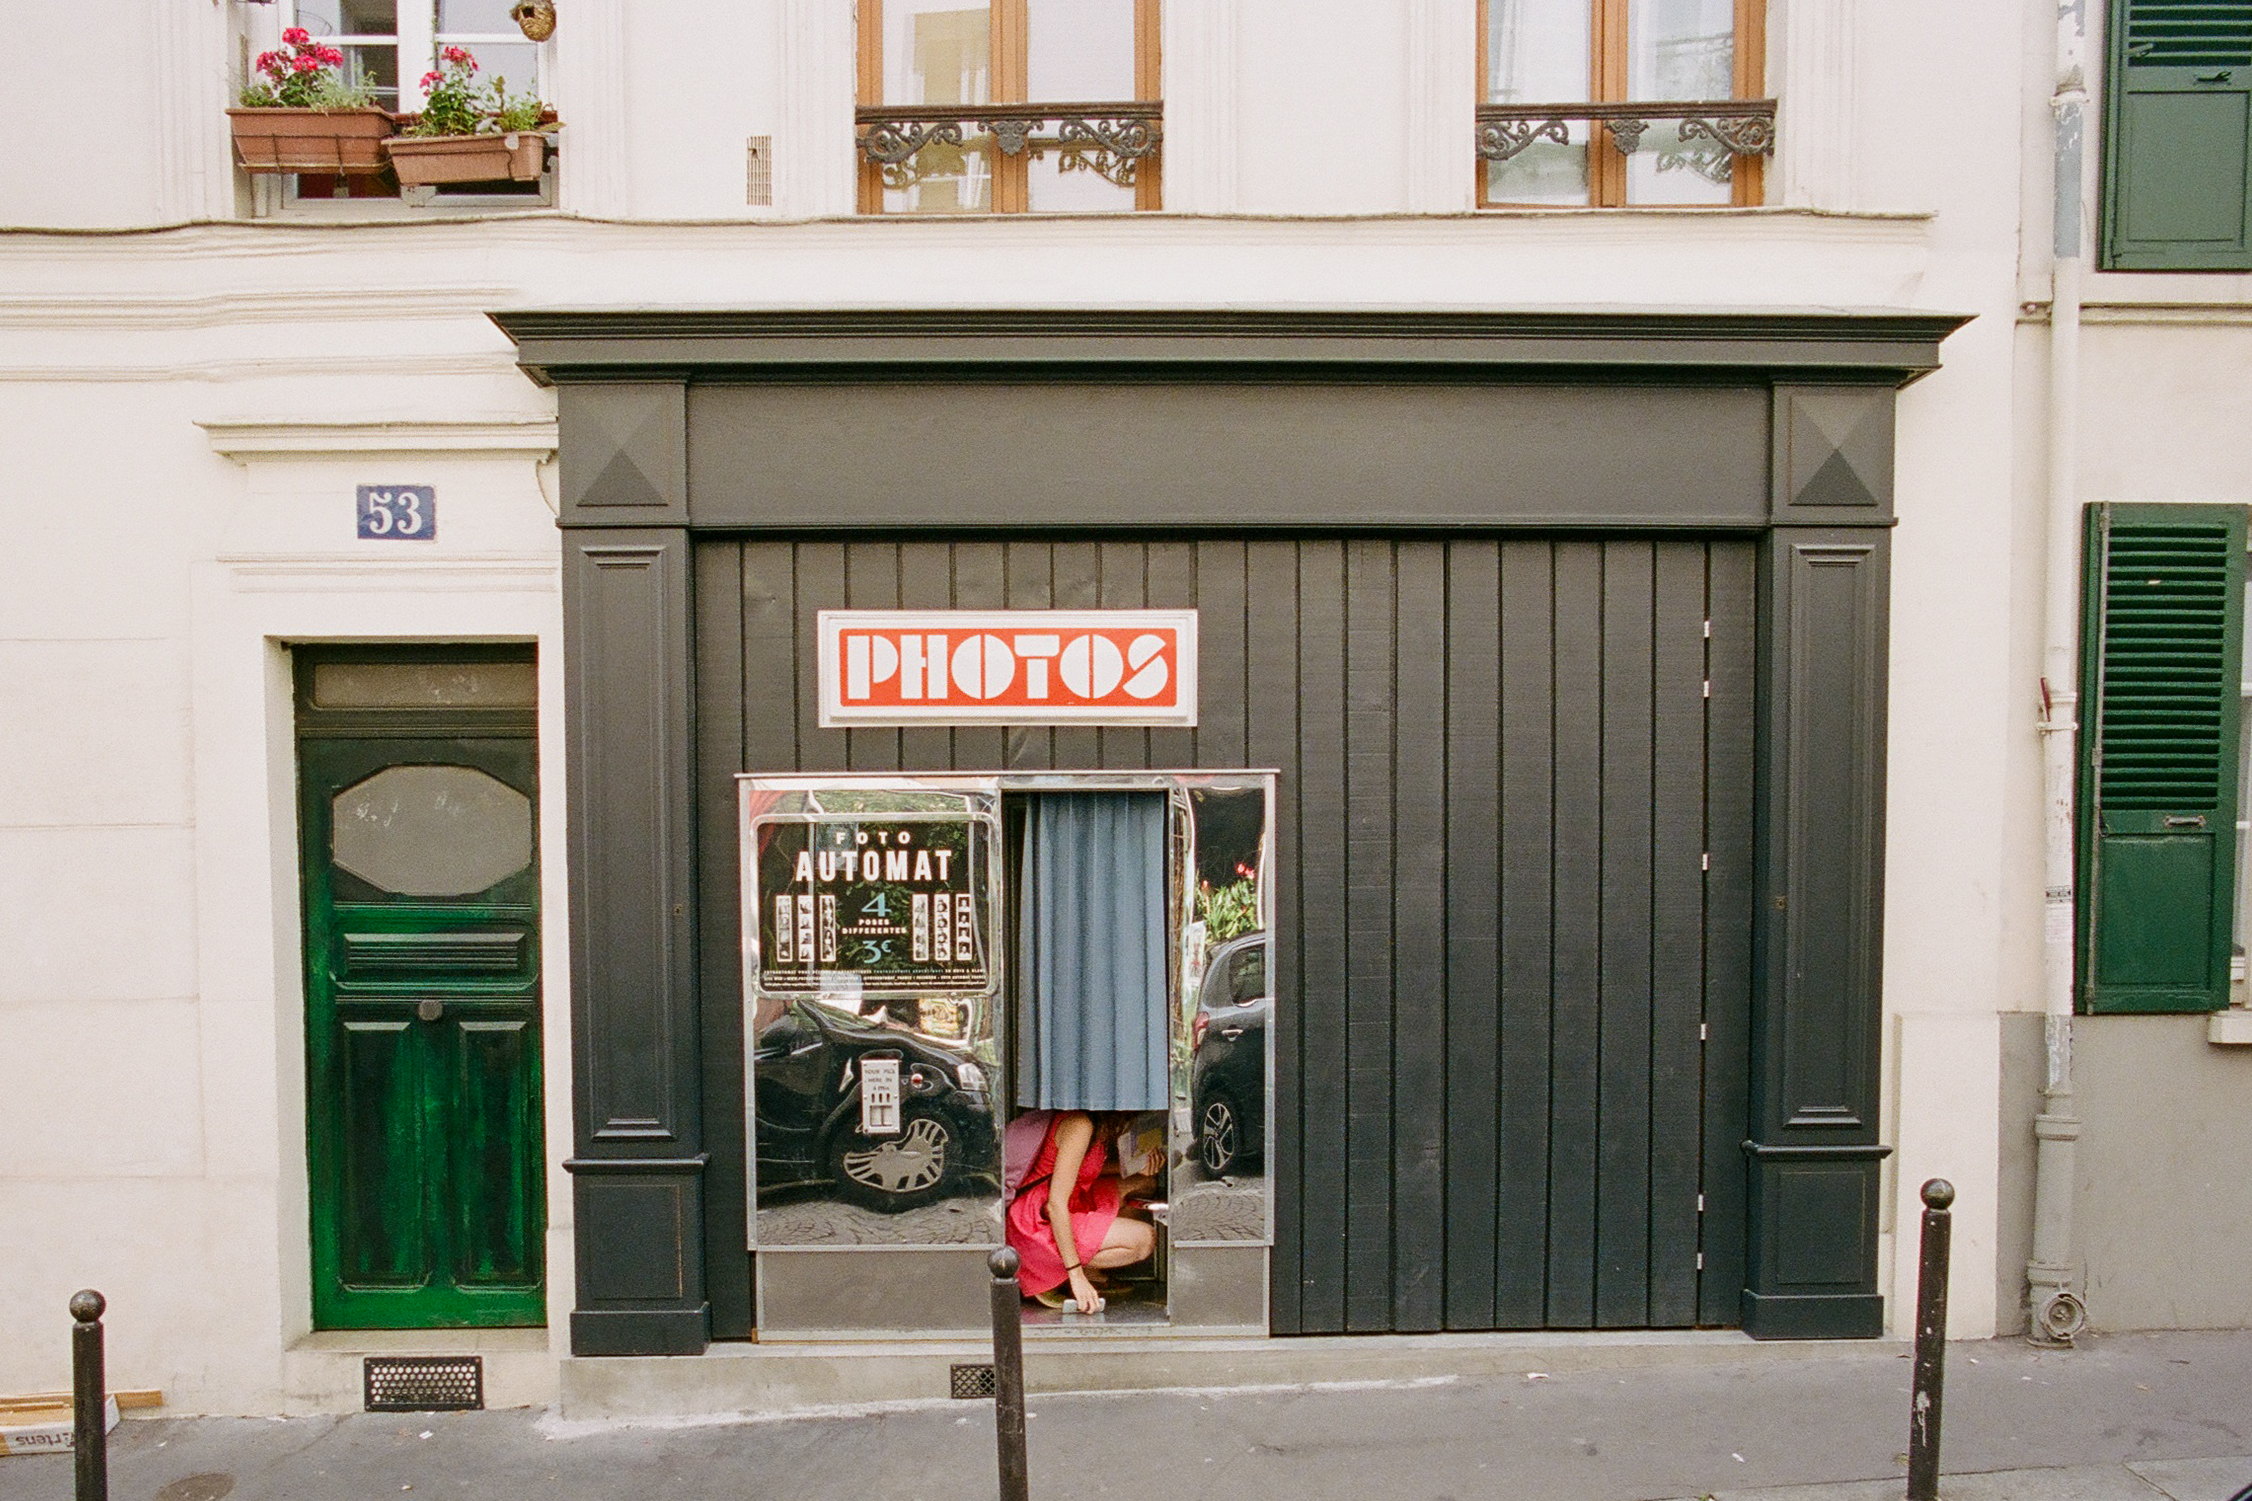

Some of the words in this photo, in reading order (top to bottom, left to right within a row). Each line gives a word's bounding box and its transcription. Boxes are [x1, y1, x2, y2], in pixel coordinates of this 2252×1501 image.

[369, 492, 422, 535] 53
[847, 633, 1169, 700] PHOTOS
[835, 831, 911, 845] FOTO
[795, 850, 952, 882] AUTOMAT
[861, 892, 892, 917] 4
[858, 918, 890, 926] POSES
[862, 939, 892, 964] 3€
